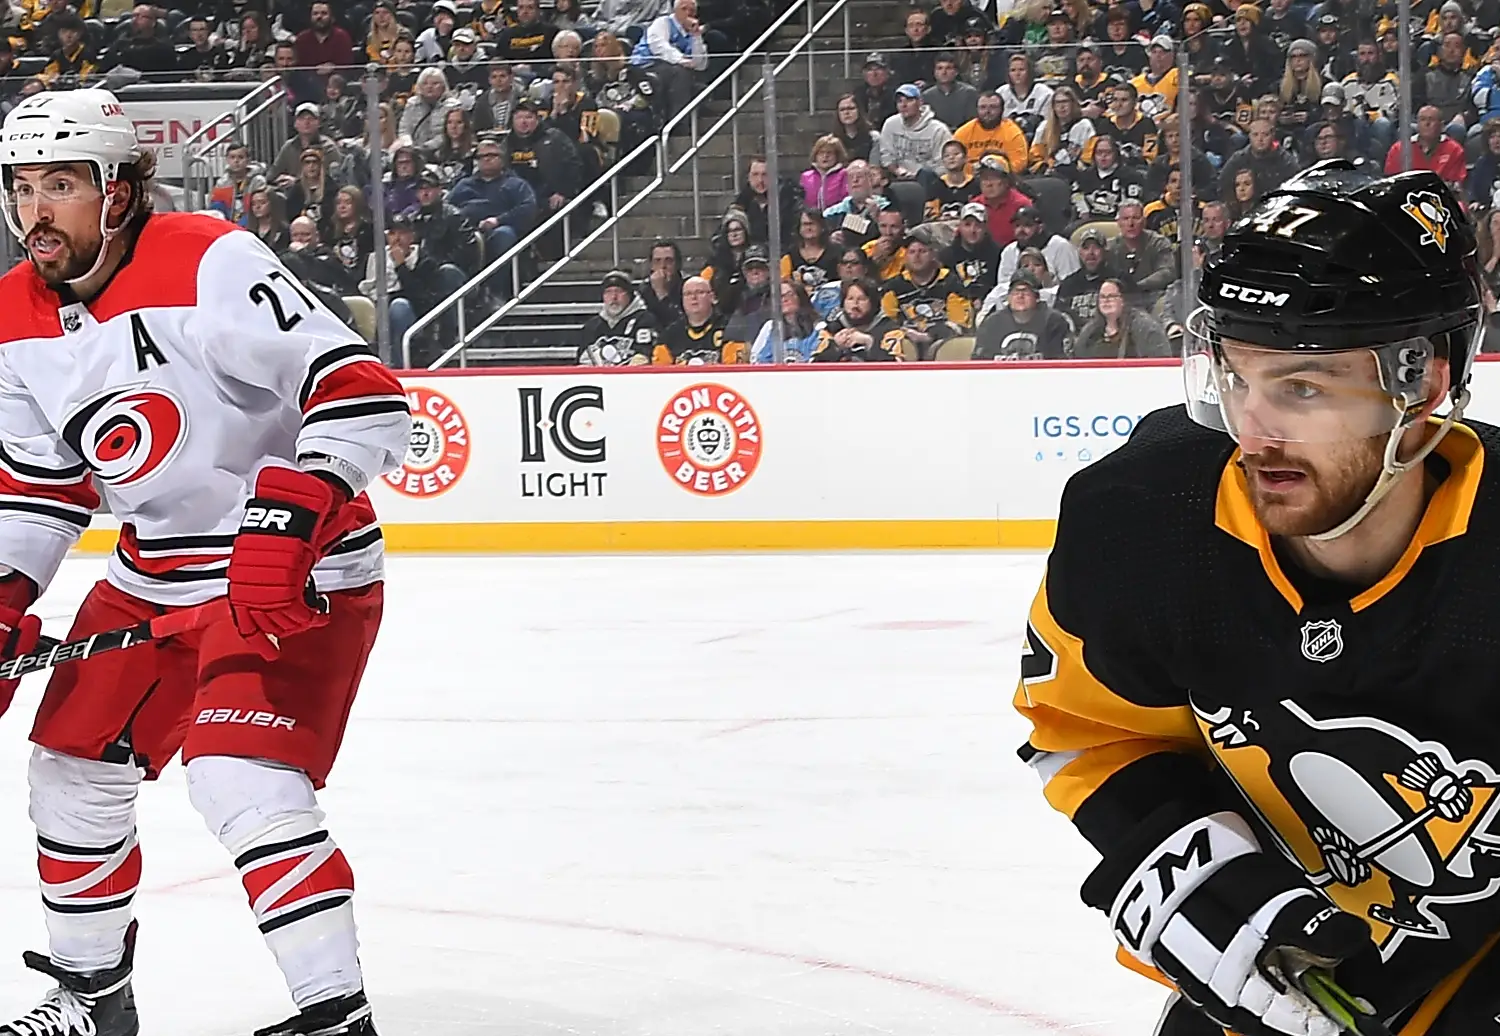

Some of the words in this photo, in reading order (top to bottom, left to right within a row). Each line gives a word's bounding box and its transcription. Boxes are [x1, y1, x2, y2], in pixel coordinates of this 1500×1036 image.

[9, 133, 45, 142] CCM
[1252, 206, 1323, 238] 47
[249, 270, 317, 332] 27
[1218, 282, 1292, 307] CCM
[130, 312, 169, 372] A
[425, 395, 467, 446] CITY
[518, 385, 606, 463] IC
[660, 387, 712, 443] IRON
[716, 392, 759, 444] CITY
[1034, 415, 1143, 438] IGS.CO
[387, 464, 457, 494] BEER
[521, 472, 607, 497] LIGHT
[674, 460, 747, 492] BEER
[1311, 631, 1334, 654] NHL
[195, 708, 297, 732] BAUER
[1114, 825, 1214, 952] CM
